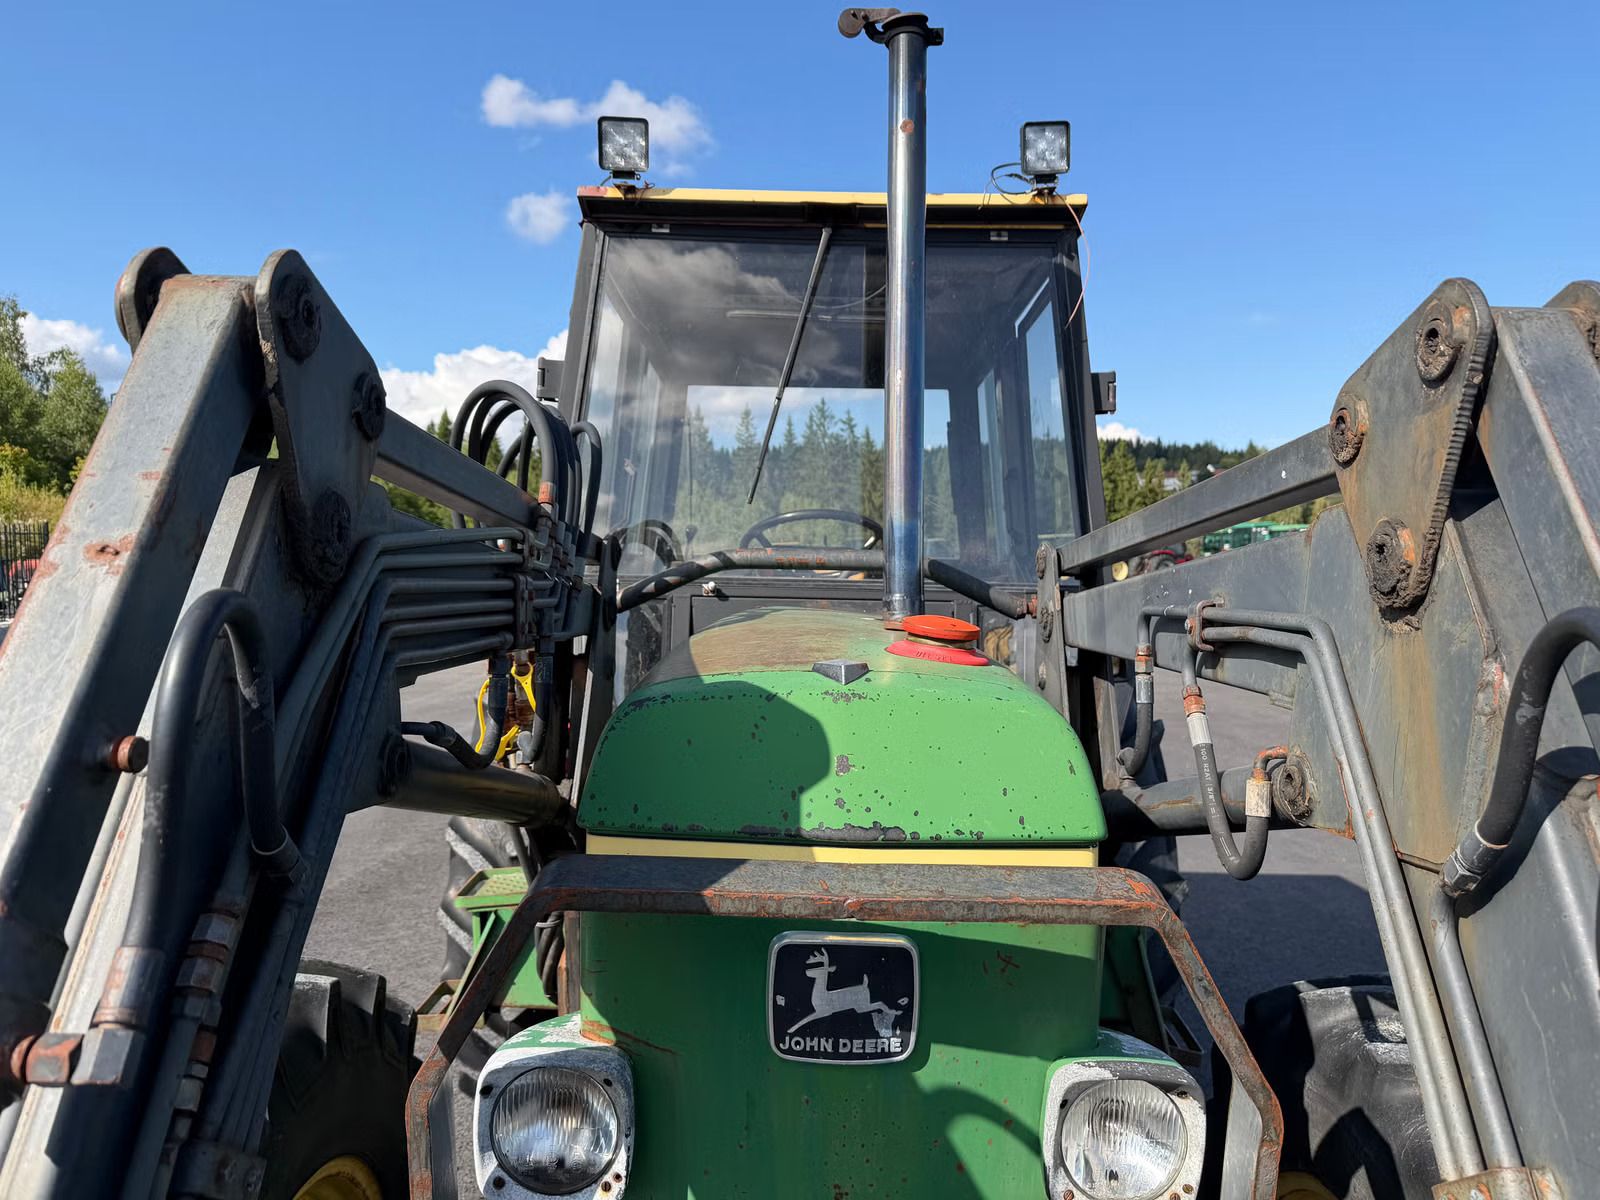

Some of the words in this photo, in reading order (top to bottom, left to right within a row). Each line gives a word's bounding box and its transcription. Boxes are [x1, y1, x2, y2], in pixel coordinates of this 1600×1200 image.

[1200, 748, 1208, 760] 100
[779, 1035, 834, 1053] JOHN
[838, 1037, 903, 1053] DEERE
